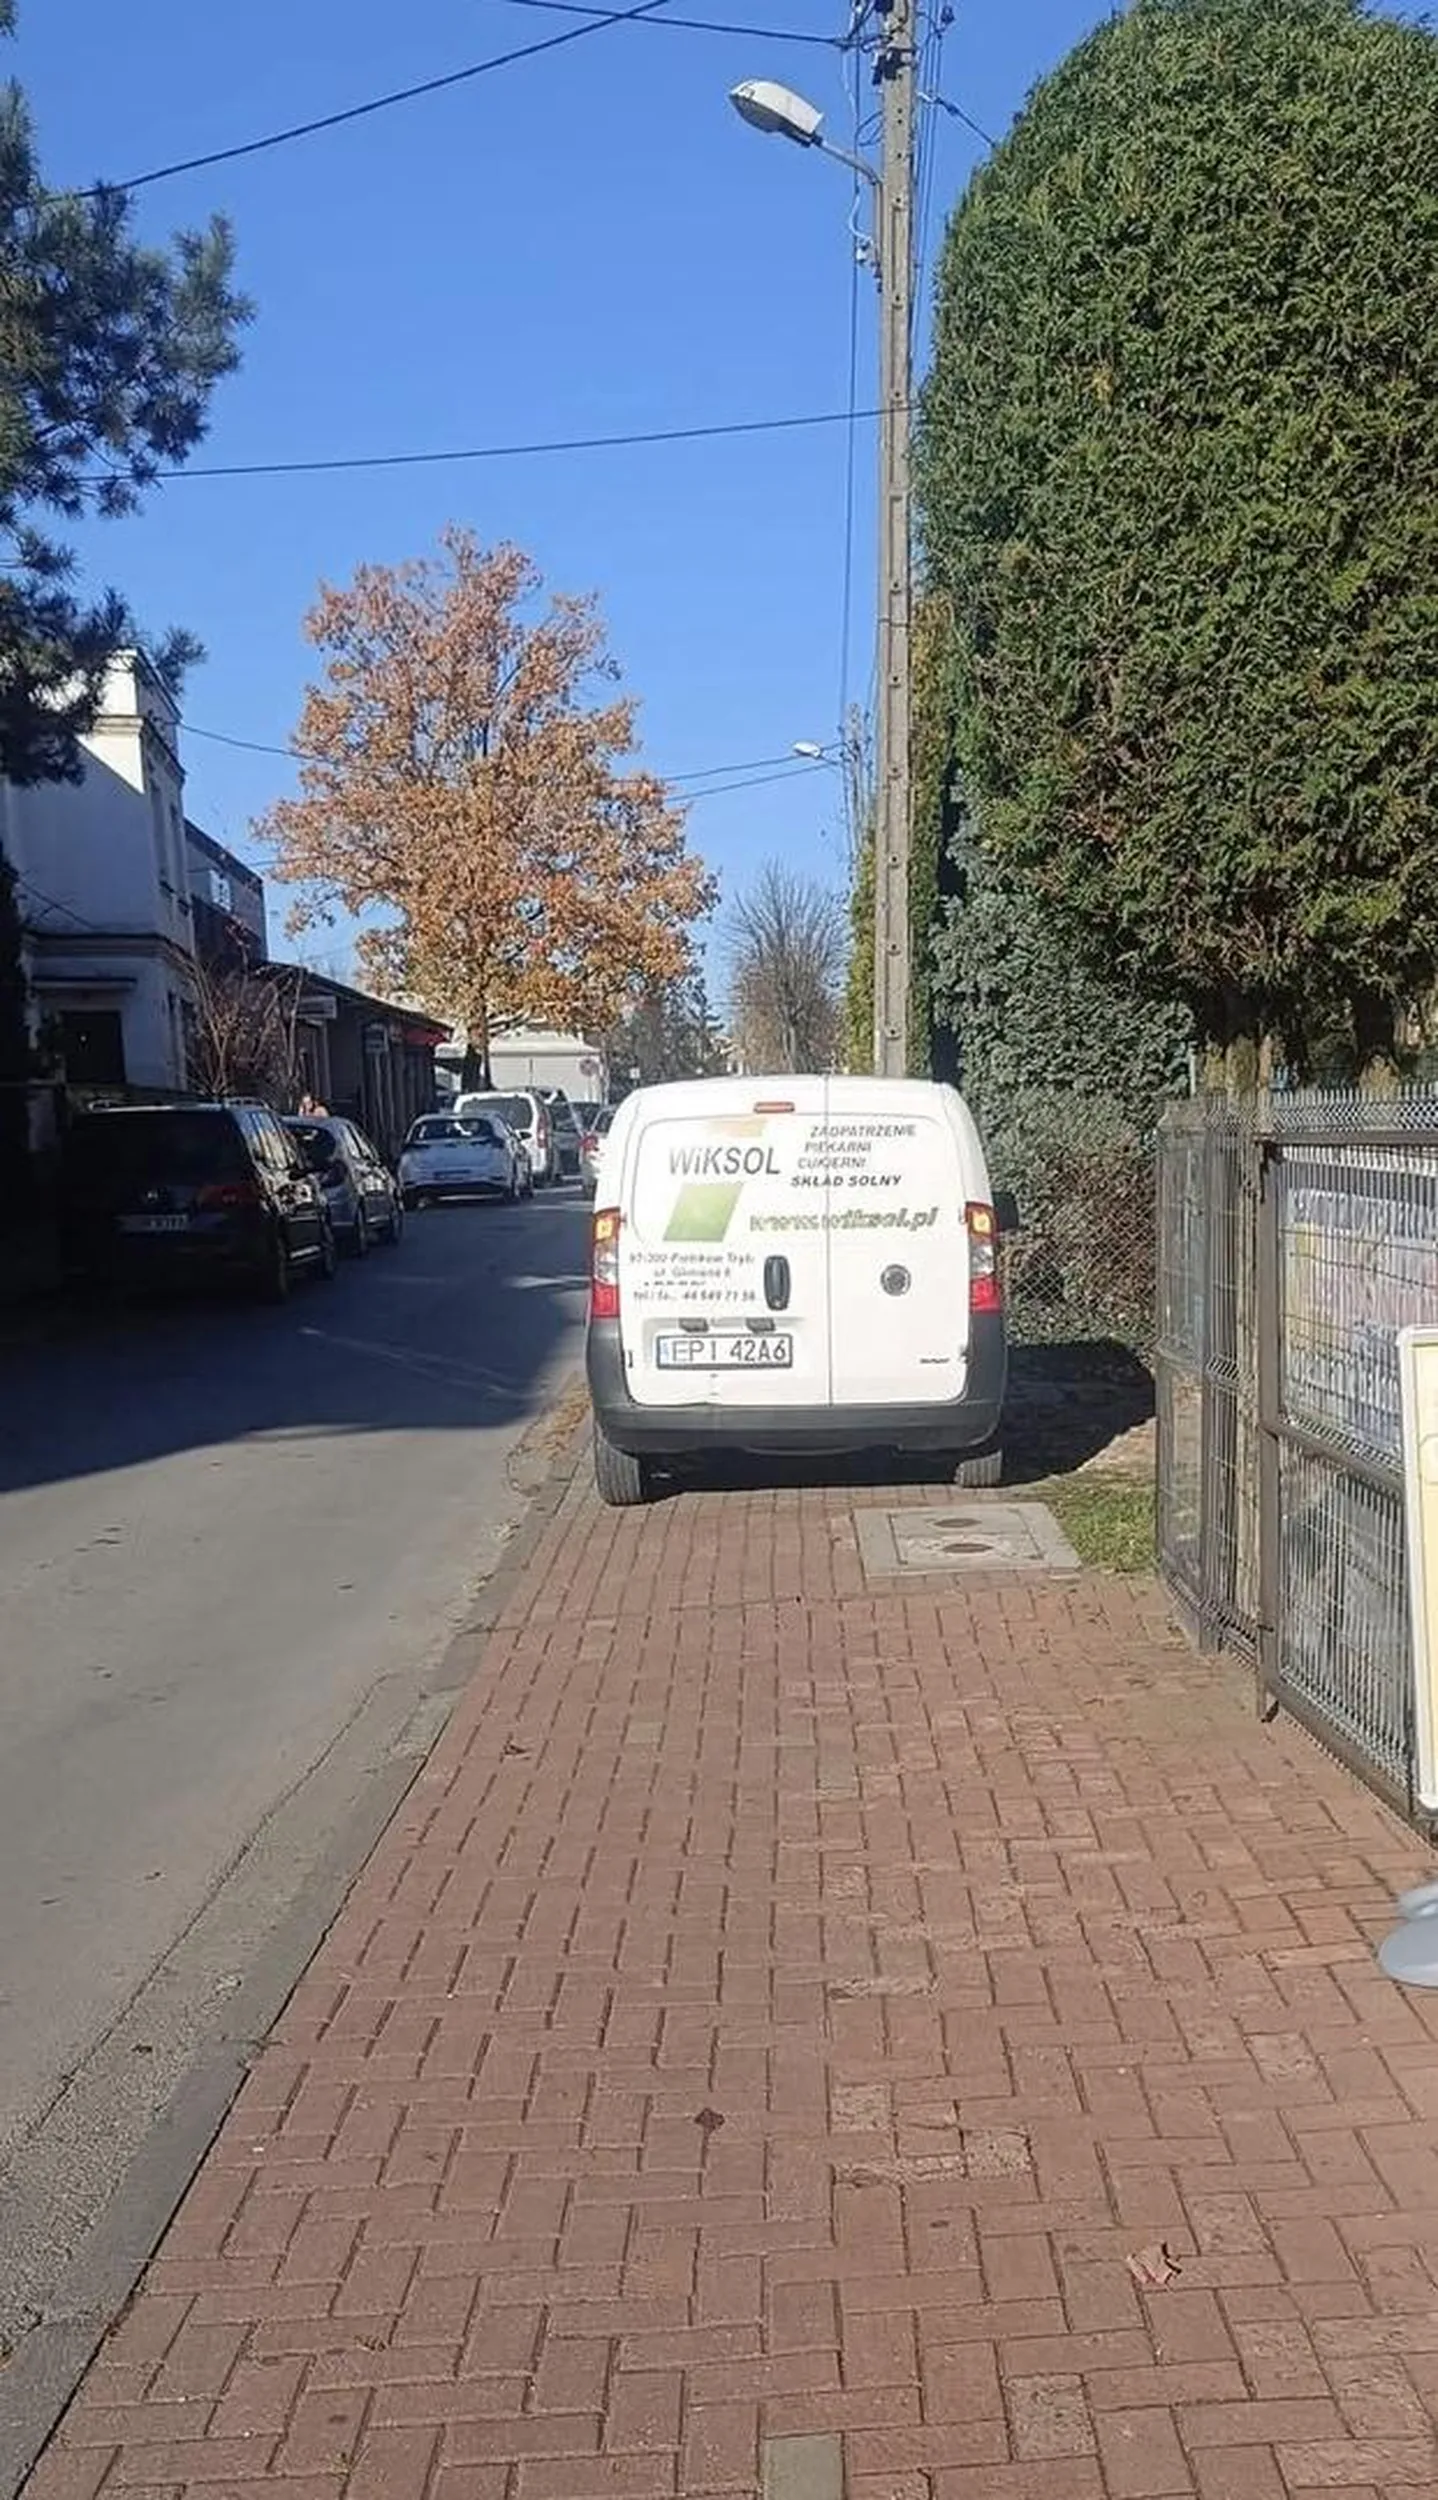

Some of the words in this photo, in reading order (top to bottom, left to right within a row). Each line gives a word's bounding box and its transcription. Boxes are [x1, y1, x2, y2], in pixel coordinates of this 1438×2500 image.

[847, 1174, 902, 1187] SOLNY
[671, 1339, 717, 1362] EPI
[729, 1339, 787, 1362] 42A6
